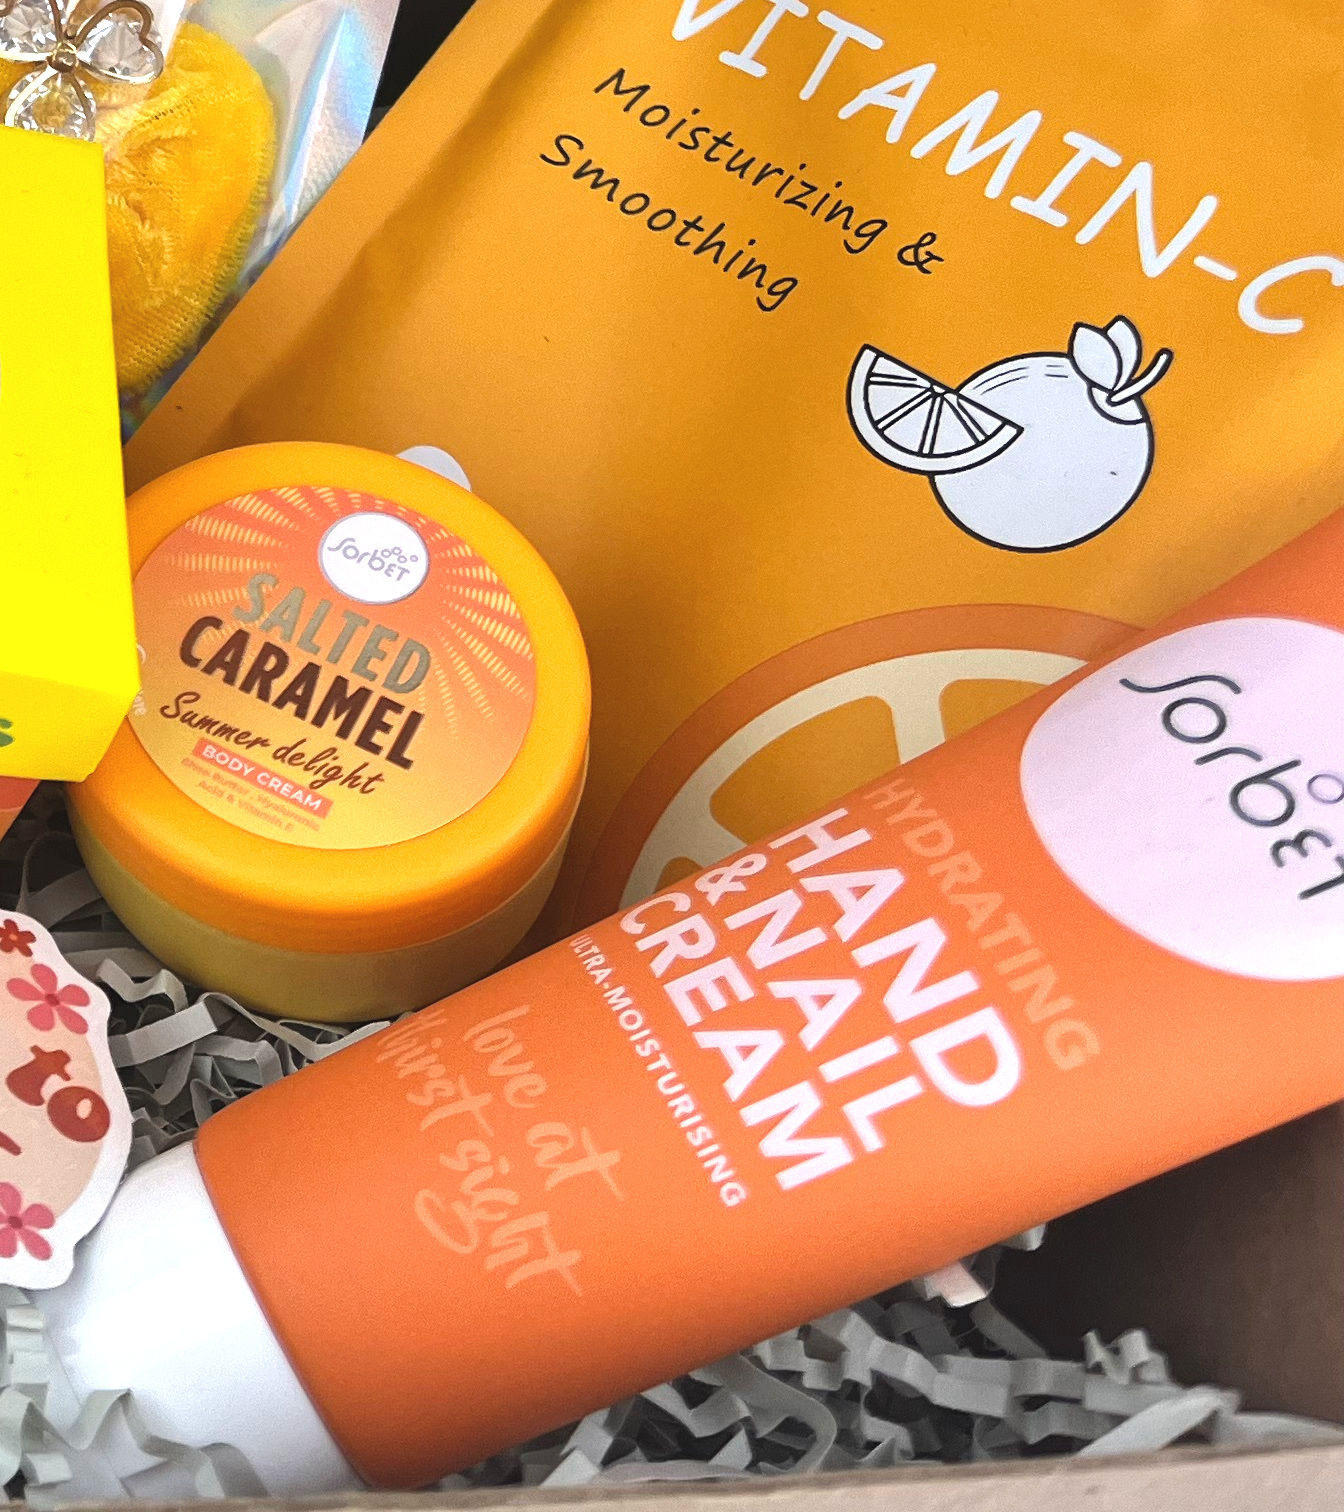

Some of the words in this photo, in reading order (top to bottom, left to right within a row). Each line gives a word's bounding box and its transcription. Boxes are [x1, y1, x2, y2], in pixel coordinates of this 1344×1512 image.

[539, 134, 800, 312] Smoothing
[593, 67, 889, 254] Moisturizing
[897, 233, 944, 275] &
[179, 616, 425, 770] CARAMEL
[234, 572, 432, 694] SALTED
[160, 691, 271, 750] Summer
[272, 738, 384, 795] delight
[202, 745, 256, 776] BODY
[257, 772, 324, 812] CREAM
[768, 807, 1023, 1110] HAND
[864, 777, 1101, 1072] HYDRATING
[5, 1045, 111, 1143] to
[462, 1004, 548, 1108] love
[526, 1122, 624, 1202] at
[568, 932, 751, 1209] ULTRA-MOISTURISING
[620, 891, 855, 1192] CREAM
[414, 1139, 583, 1297] sight
